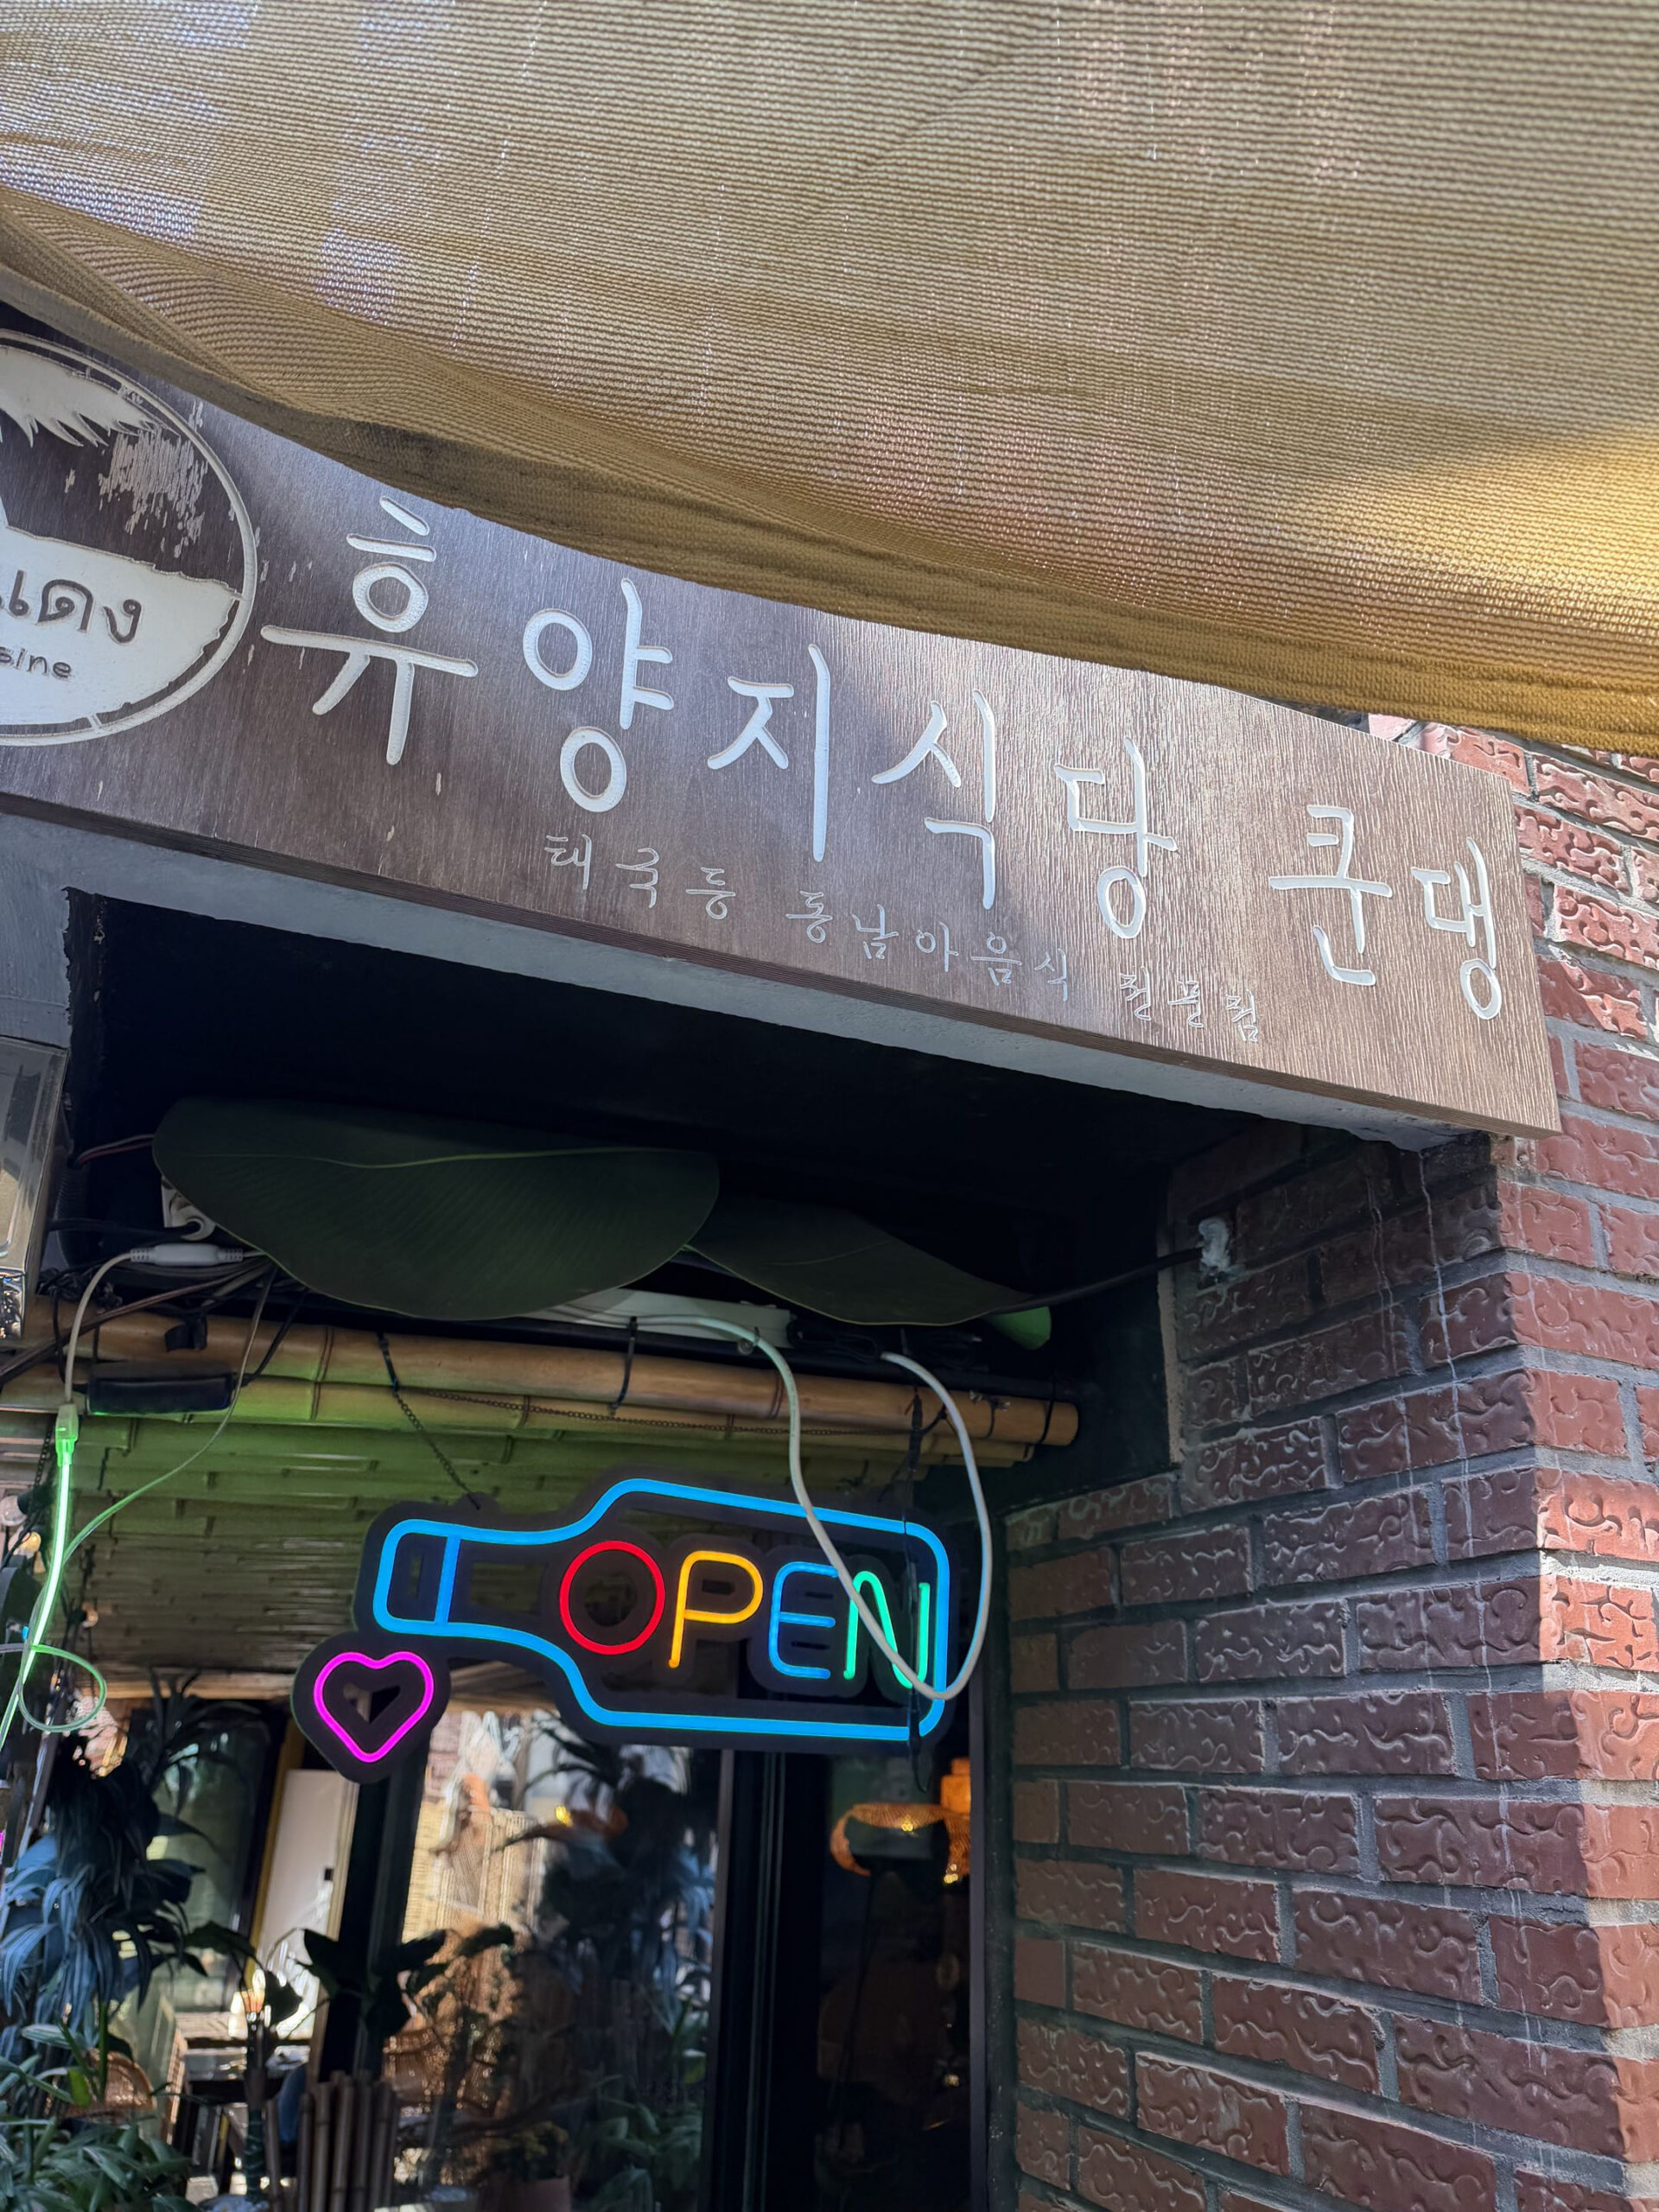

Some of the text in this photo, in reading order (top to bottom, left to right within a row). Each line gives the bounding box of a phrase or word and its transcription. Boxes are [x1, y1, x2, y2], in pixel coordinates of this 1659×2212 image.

[260, 495, 1503, 1020] 휴양지식당 쿤댕
[785, 890, 1070, 1001] 동남아음식
[1119, 965, 1259, 1043] 전문점
[560, 1541, 930, 1688] OPEN
